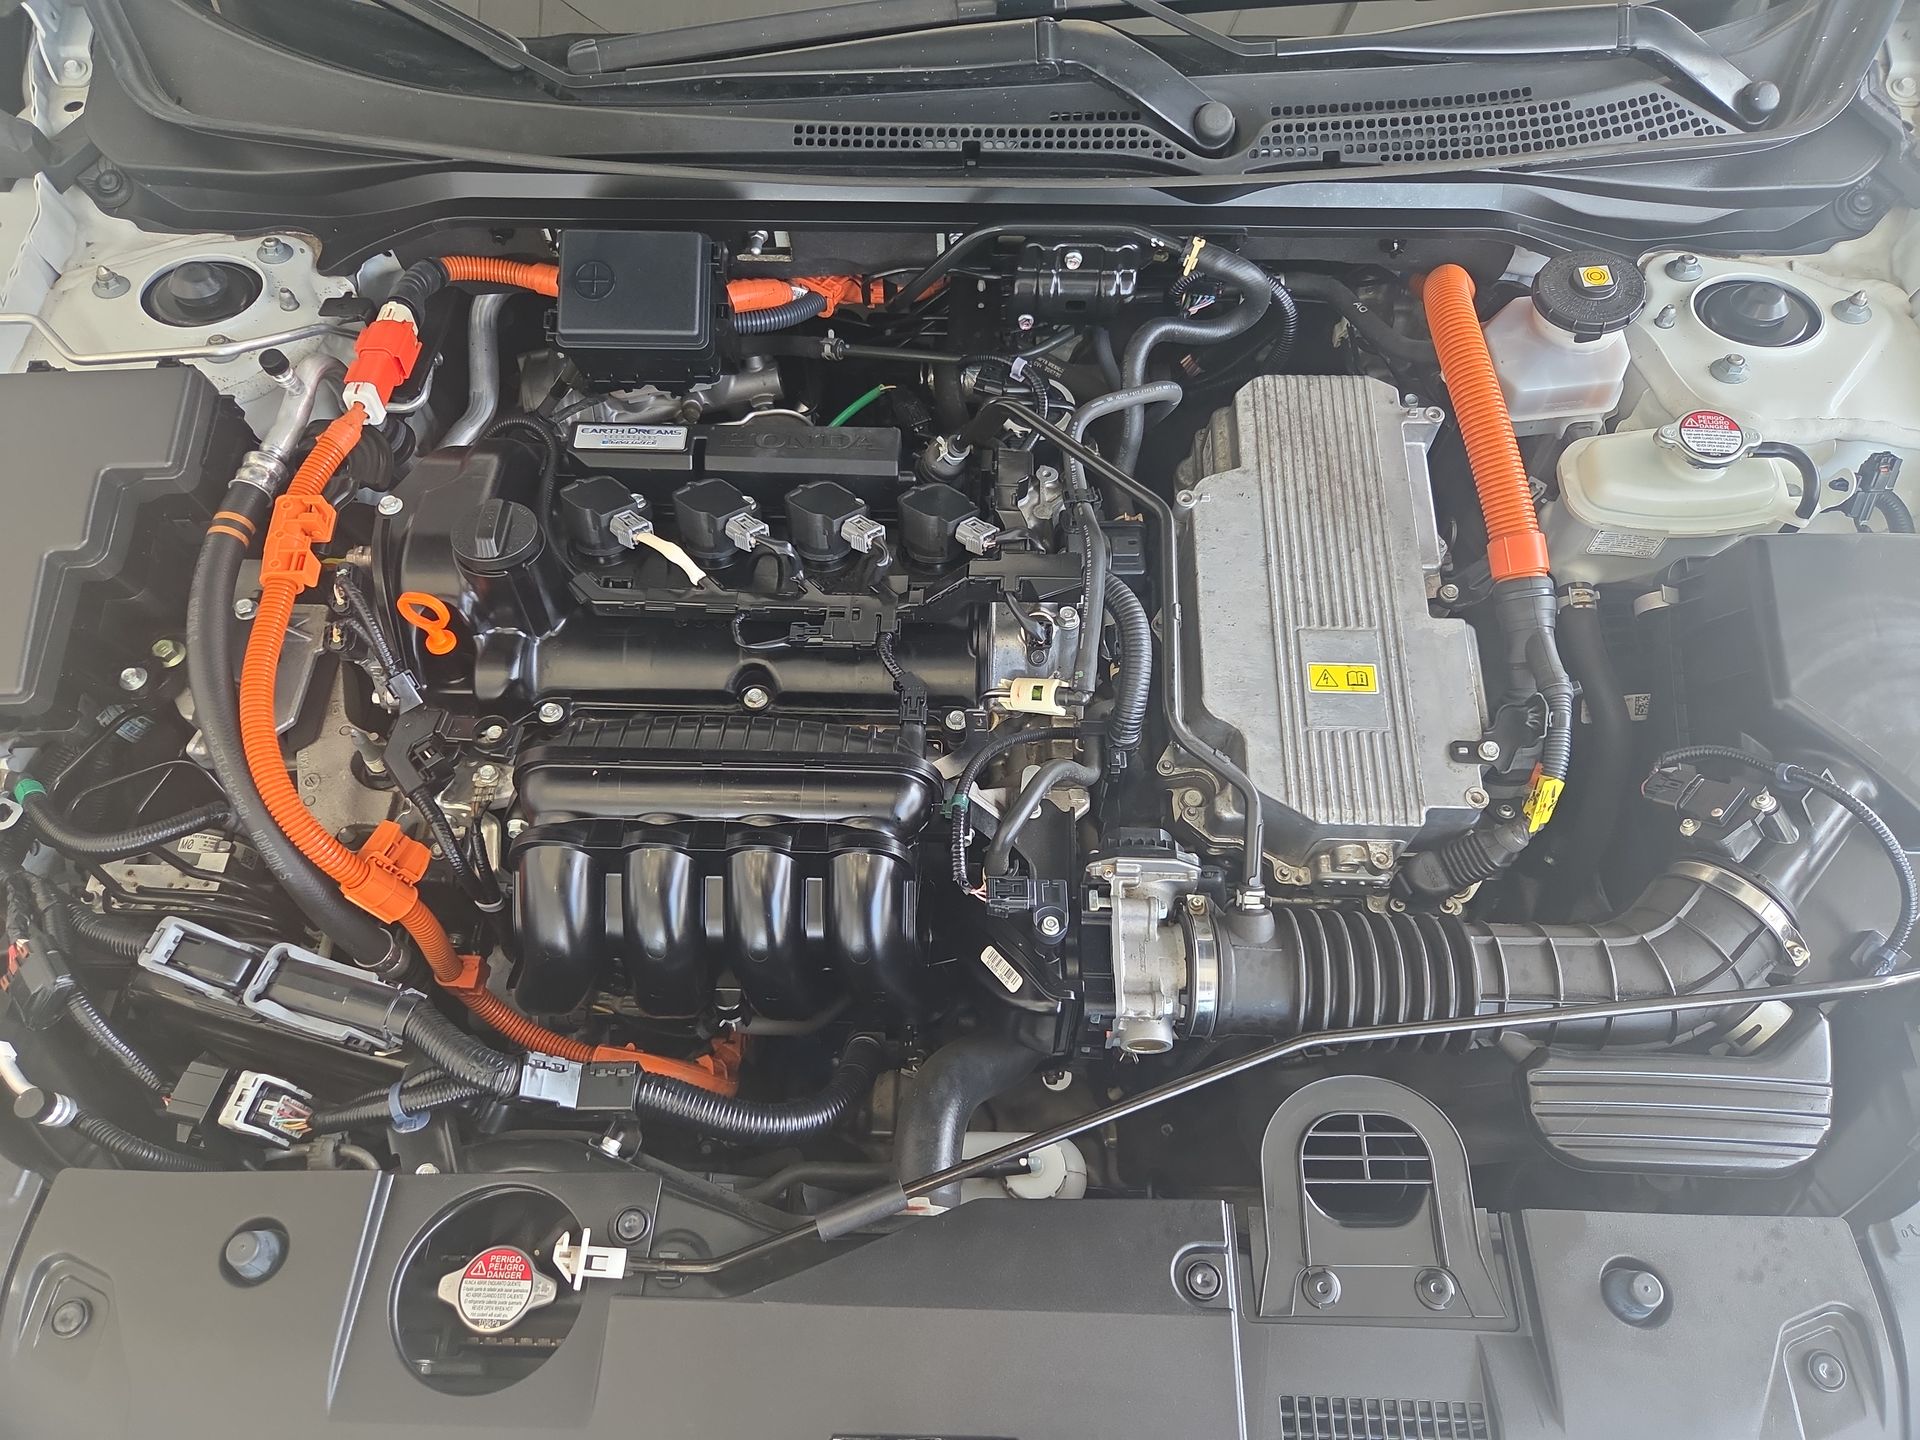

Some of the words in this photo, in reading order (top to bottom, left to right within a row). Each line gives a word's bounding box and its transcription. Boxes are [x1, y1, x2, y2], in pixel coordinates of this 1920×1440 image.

[581, 427, 625, 435] EARTH
[627, 427, 682, 436] DREAMS
[719, 432, 884, 450] HONDA
[490, 1255, 522, 1263] PERIGO
[488, 1263, 525, 1272] PELIGRO
[486, 1271, 522, 1279] DANGER
